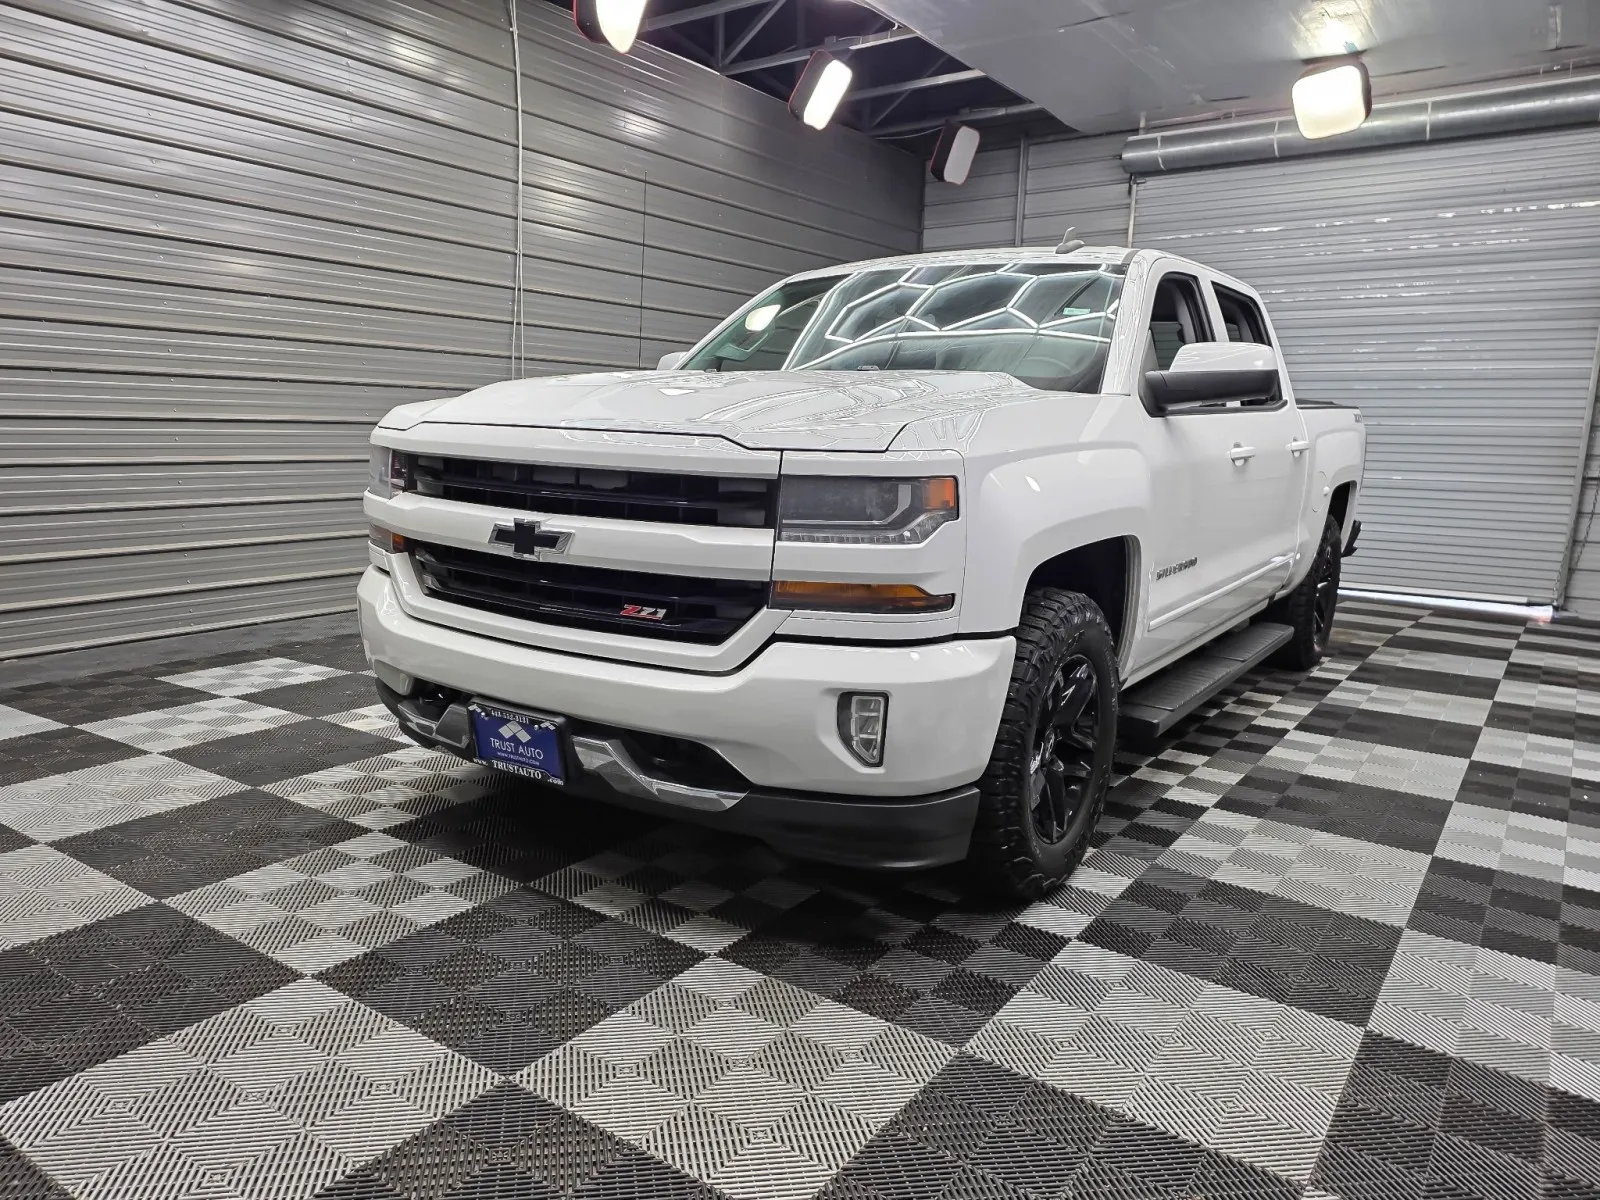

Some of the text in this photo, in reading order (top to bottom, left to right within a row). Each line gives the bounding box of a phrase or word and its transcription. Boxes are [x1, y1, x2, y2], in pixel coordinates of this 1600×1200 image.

[620, 604, 667, 620] Z71
[490, 738, 543, 760] TRUST AUTO
[491, 760, 542, 779] TRUSTAUTO
